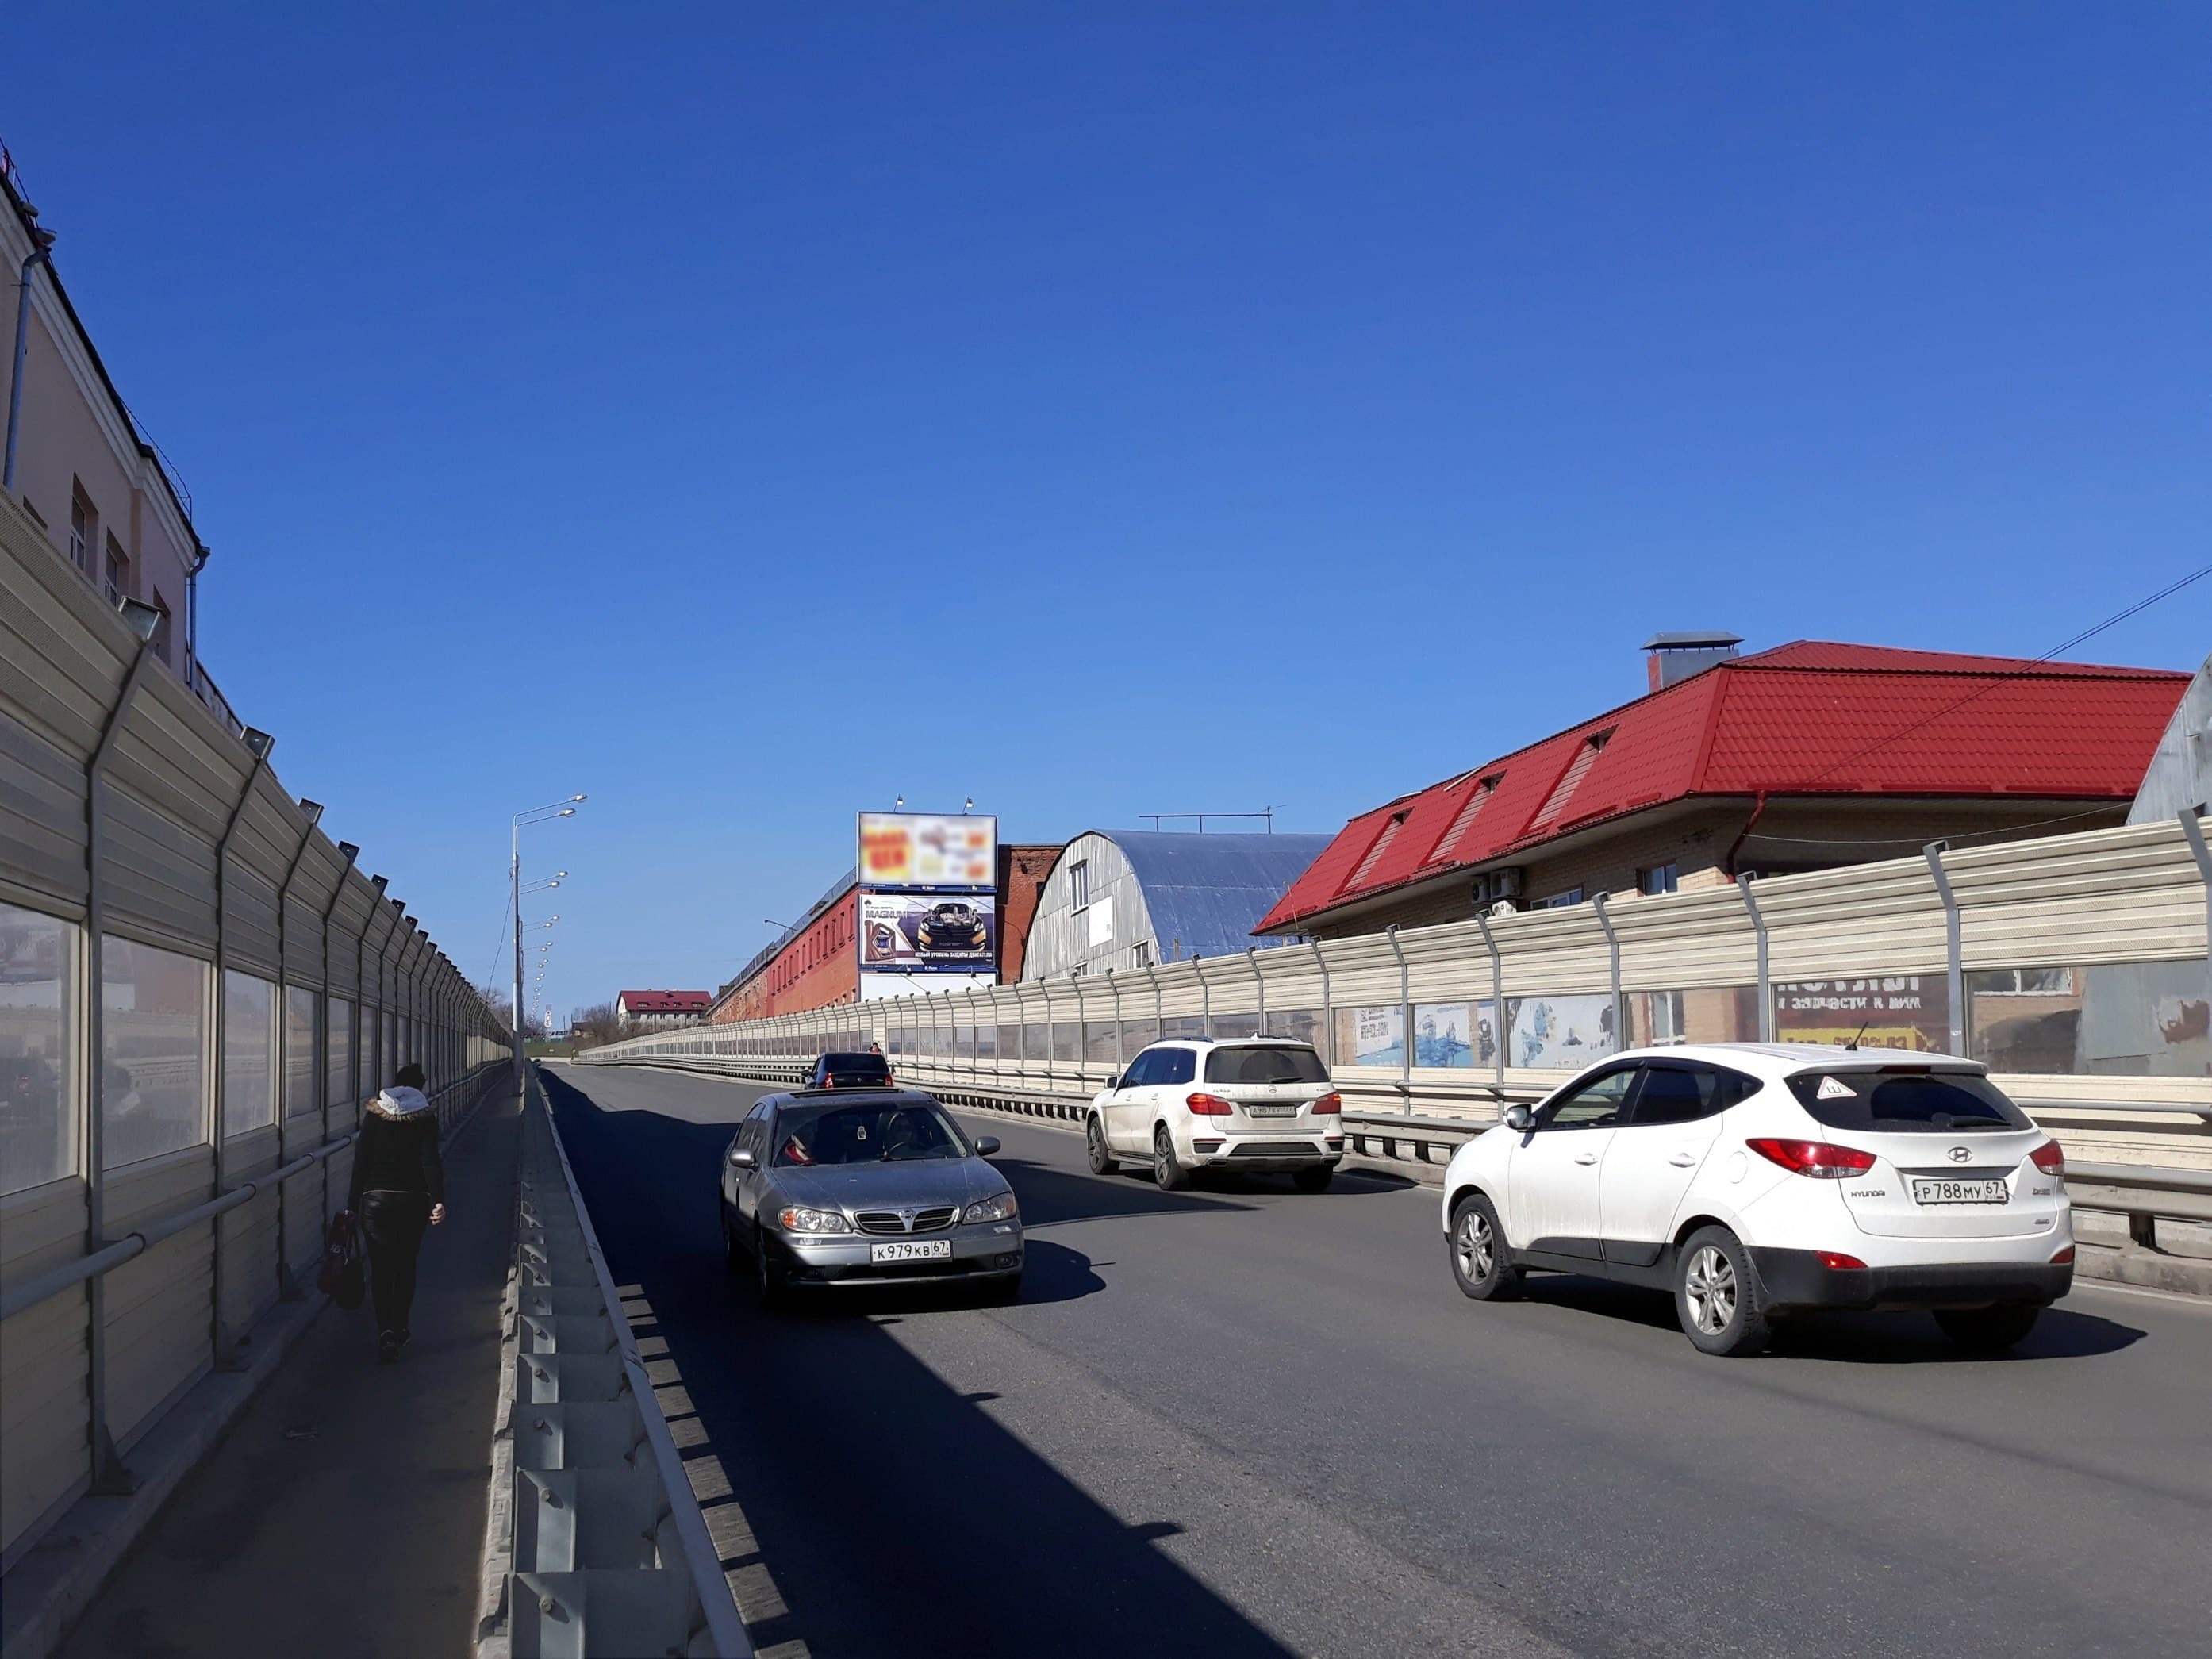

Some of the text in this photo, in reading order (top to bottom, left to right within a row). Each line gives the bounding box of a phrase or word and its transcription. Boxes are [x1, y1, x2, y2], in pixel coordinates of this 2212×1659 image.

[866, 910, 907, 919] MAGNUM
[1985, 1181, 1999, 1194] 67
[933, 1242, 946, 1253] 67
